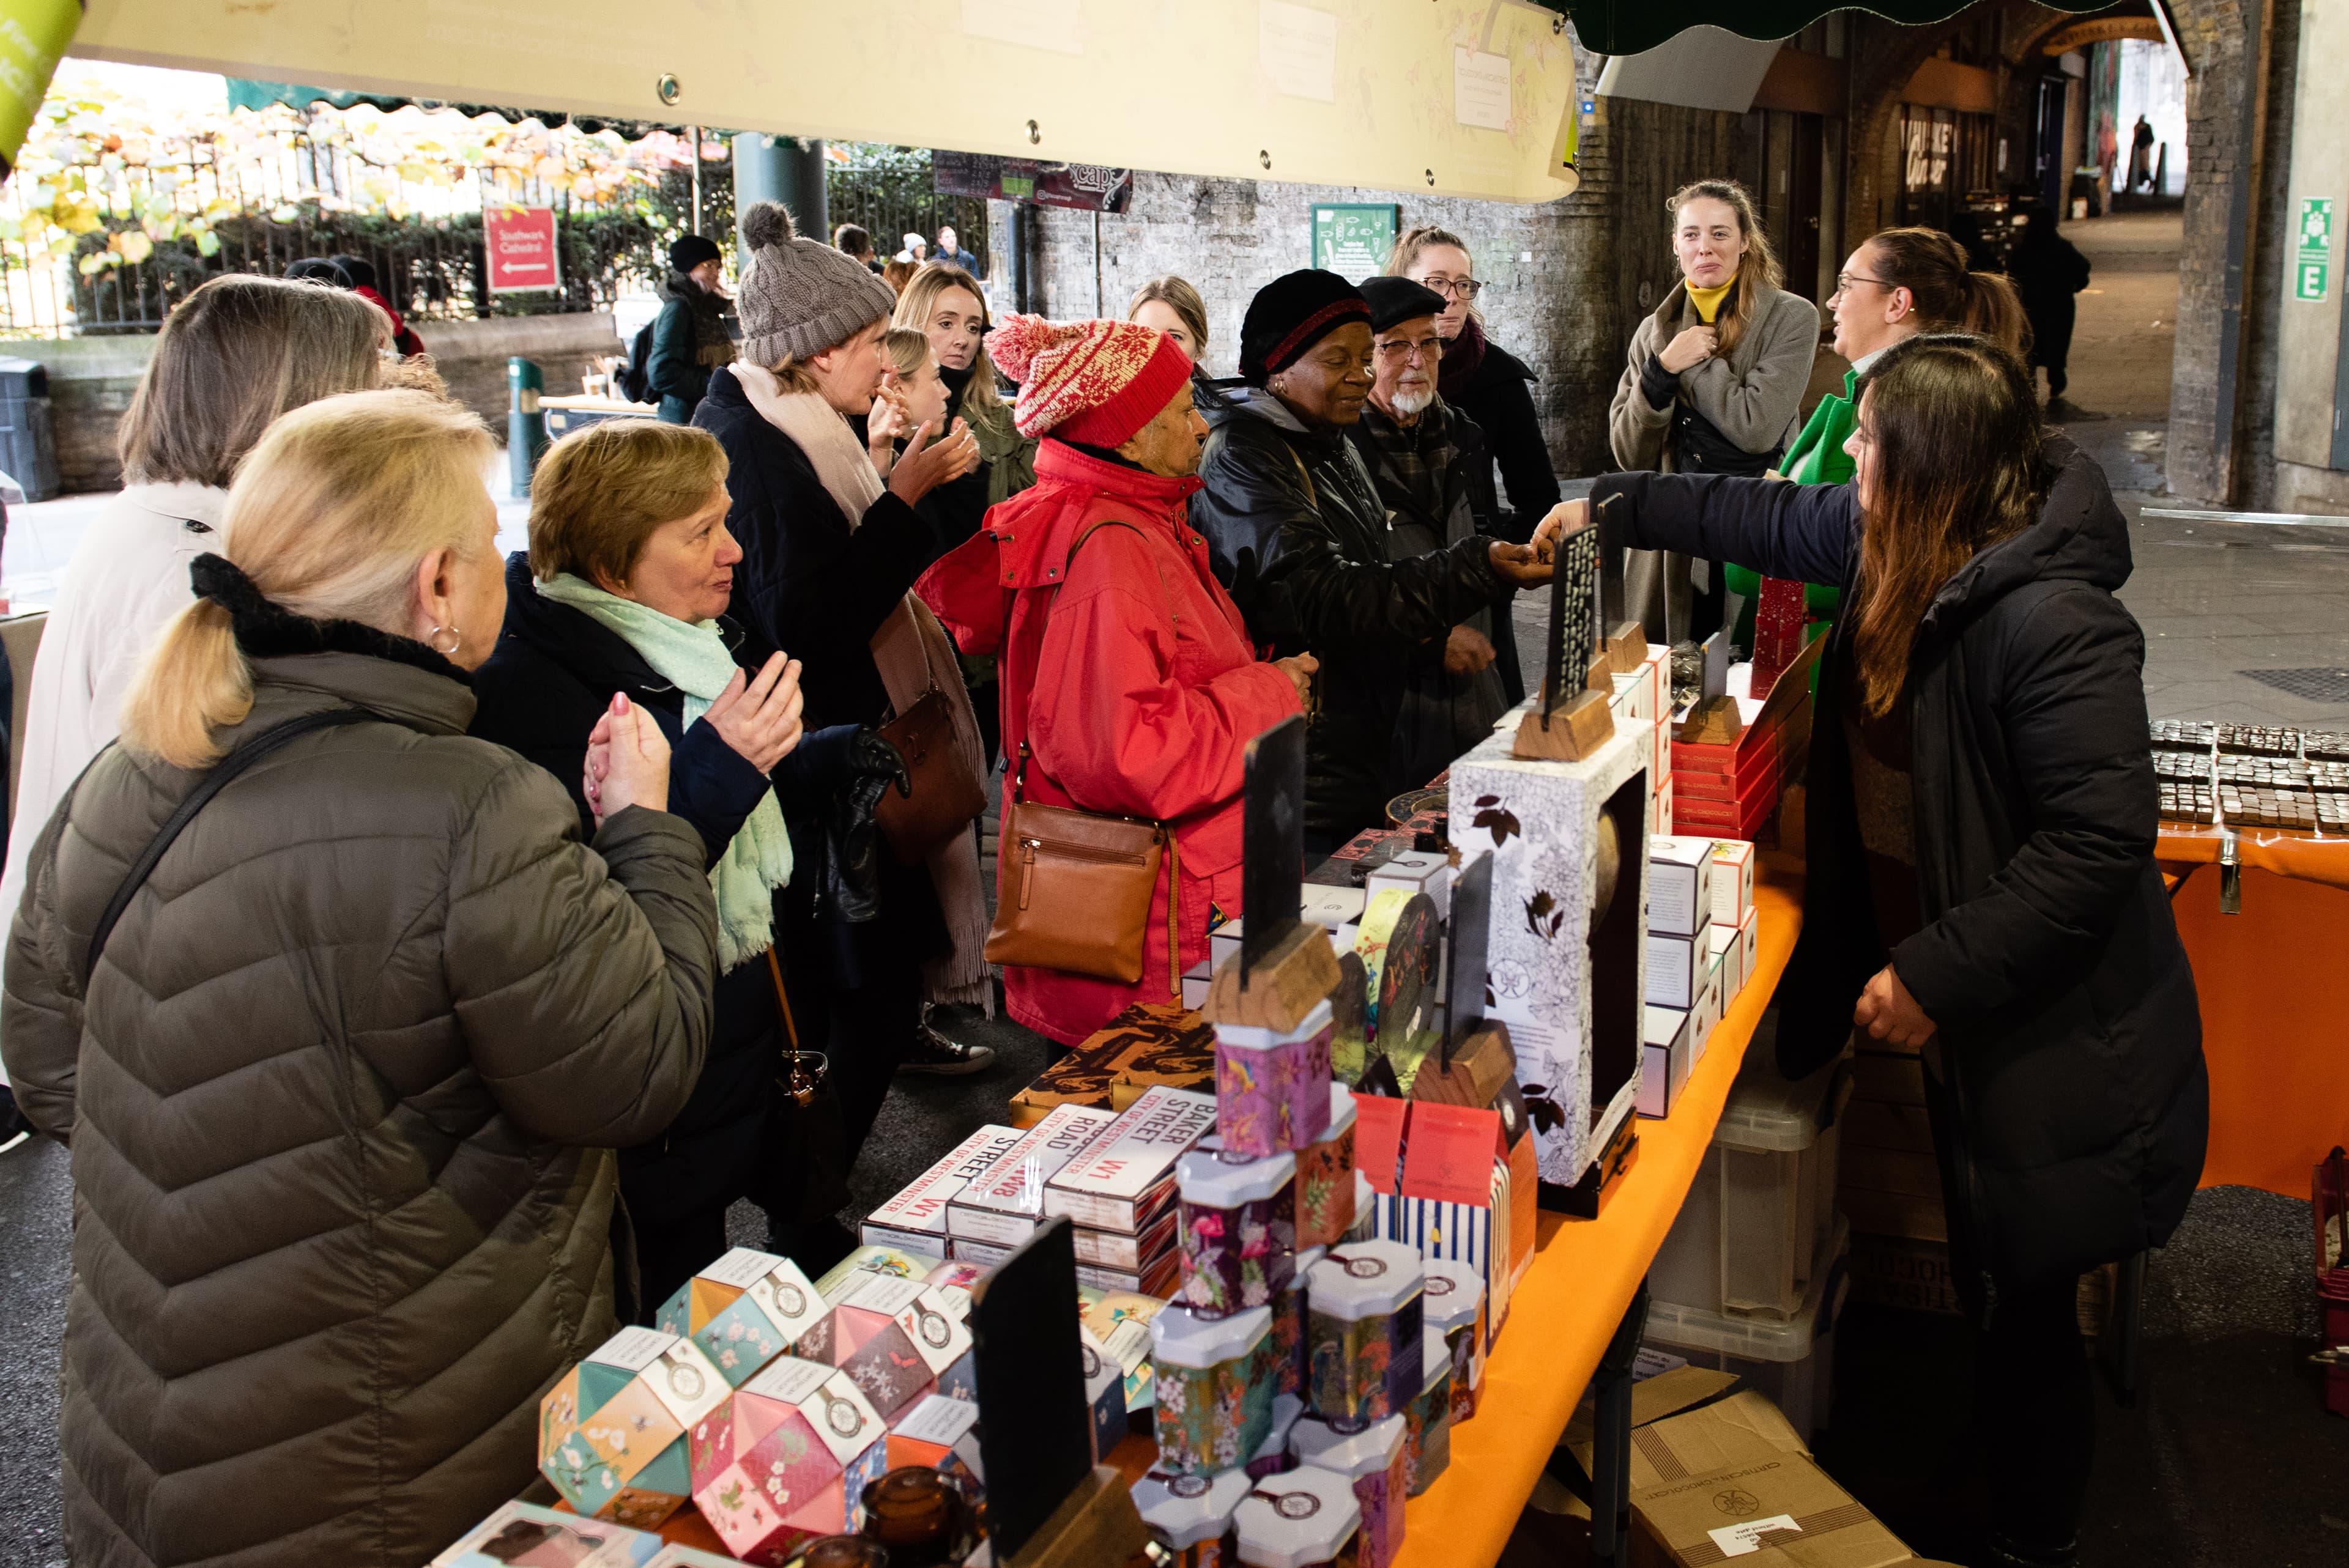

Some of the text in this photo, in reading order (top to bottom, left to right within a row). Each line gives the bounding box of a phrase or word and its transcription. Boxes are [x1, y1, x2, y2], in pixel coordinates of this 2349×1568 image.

[499, 229, 546, 240] Southwark
[499, 242, 542, 254] Cathedral
[2303, 267, 2320, 296] E
[1047, 1116, 1098, 1150] ROAD
[1065, 1095, 1161, 1174] CITY OF WESTMINSTER
[1130, 1099, 1190, 1144] STREET
[1160, 1104, 1217, 1144] BAKER
[952, 1137, 1016, 1182] STREET
[968, 1112, 1067, 1192] CITY OF WESTMINSTER
[1088, 1160, 1129, 1180] W1
[883, 1133, 990, 1212] CITY OF WESTMINSTER
[905, 1198, 948, 1218] W1
